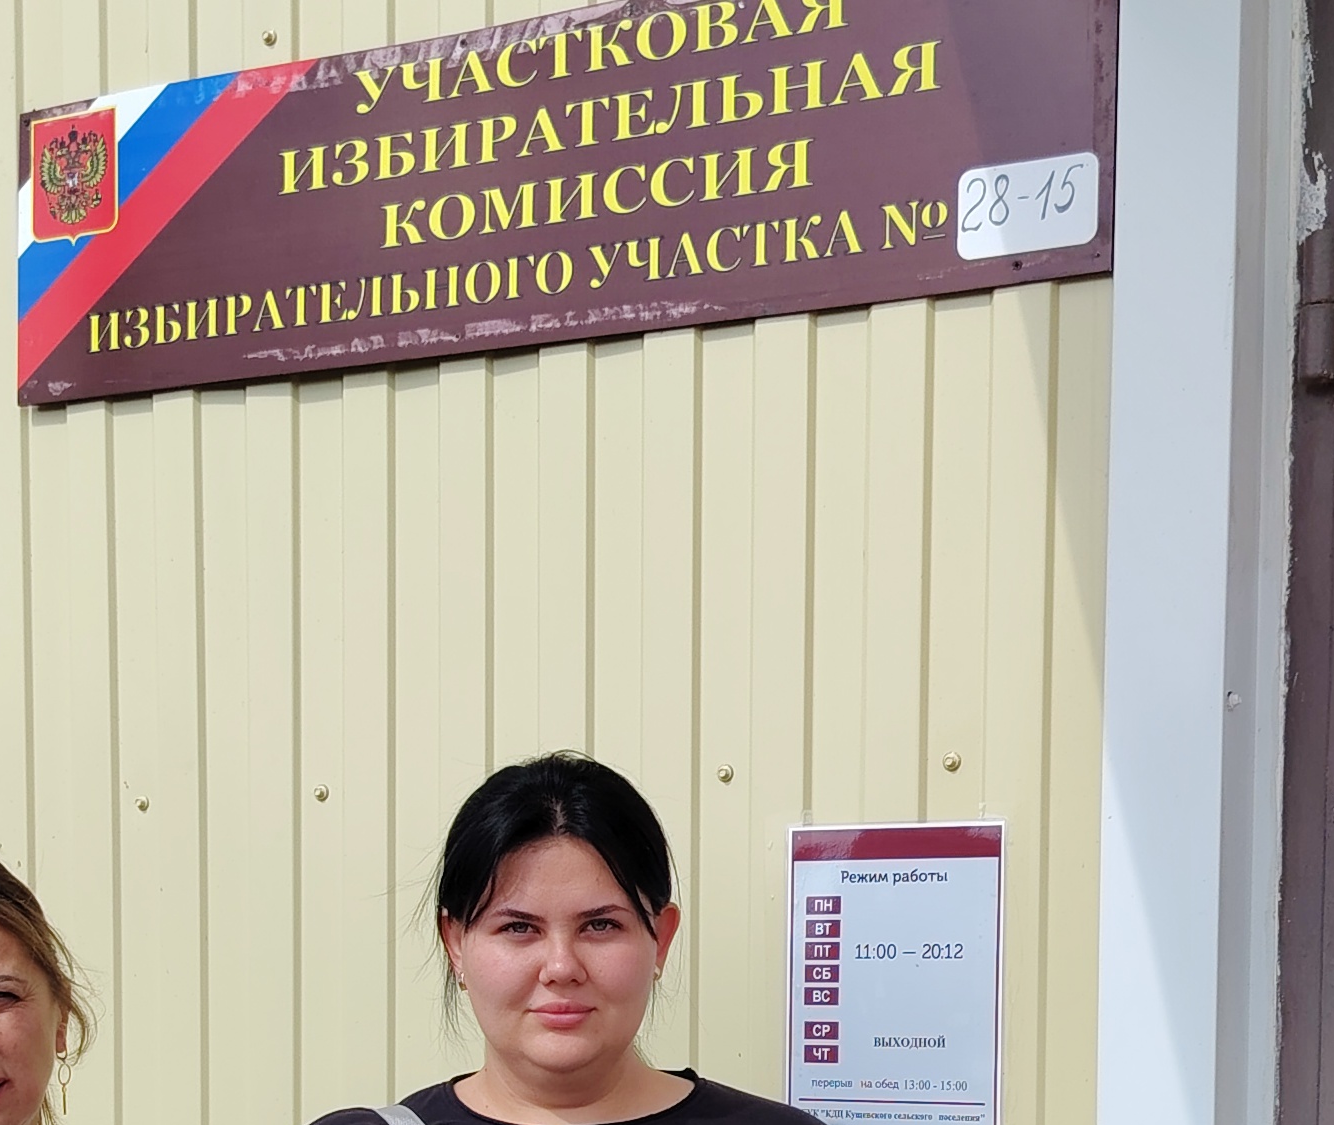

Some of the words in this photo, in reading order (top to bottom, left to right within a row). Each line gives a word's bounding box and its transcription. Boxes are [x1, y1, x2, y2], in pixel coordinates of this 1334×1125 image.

[354, 0, 848, 114] УЧАСТКОВАЯ
[278, 40, 944, 196] ИЗБИРАТЕЛЬНАЯ
[380, 138, 815, 250] КОМИССИЯ
[87, 248, 575, 354] ИЗБИРАТЕЛЬНОГО
[588, 209, 865, 290] УЧАСТКА
[880, 198, 949, 250] №
[960, 163, 1087, 232] 28-15
[841, 870, 889, 884] Режим
[892, 869, 949, 886] работы
[814, 899, 833, 912] ПН
[815, 922, 833, 936] ВТ
[814, 944, 832, 958] ПТ
[854, 943, 897, 960] 11:00
[921, 943, 964, 960] 20:12
[812, 966, 832, 980] СБ
[812, 990, 831, 1003] ВС
[812, 1024, 831, 1037] СР
[873, 1035, 946, 1049] ВЫХОДНОЙ
[813, 1047, 831, 1061] ЧТ
[811, 1079, 853, 1089] перерыв
[860, 1080, 872, 1088] на
[875, 1078, 900, 1090] обед
[903, 1079, 931, 1091] 13:00
[940, 1080, 968, 1091] 15:00
[893, 1112, 933, 1121] сельского
